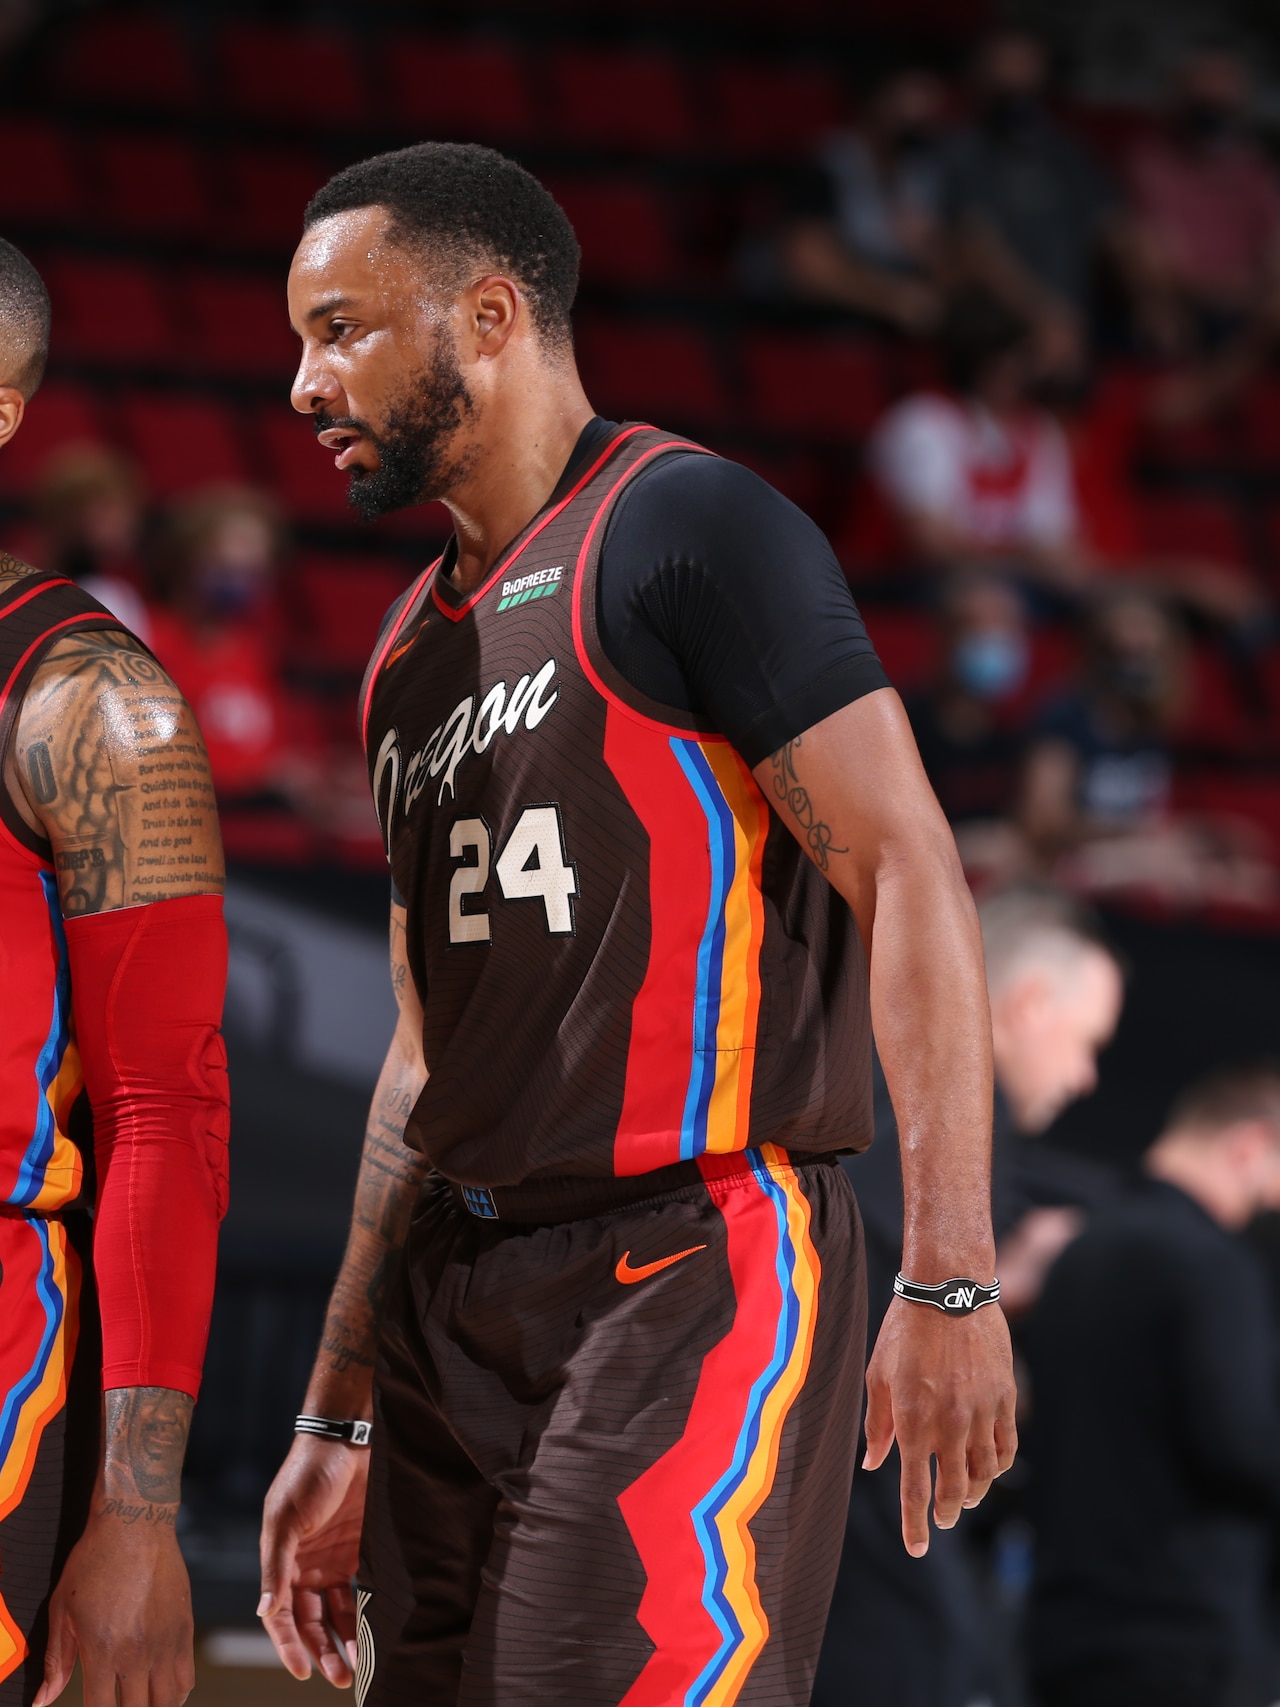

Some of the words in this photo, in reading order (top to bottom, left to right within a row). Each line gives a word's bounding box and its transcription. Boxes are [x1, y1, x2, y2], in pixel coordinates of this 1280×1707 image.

[139, 837, 160, 848] And
[174, 836, 192, 848] good
[137, 855, 166, 867] Dwell
[133, 875, 154, 885] And
[448, 804, 578, 946] 24
